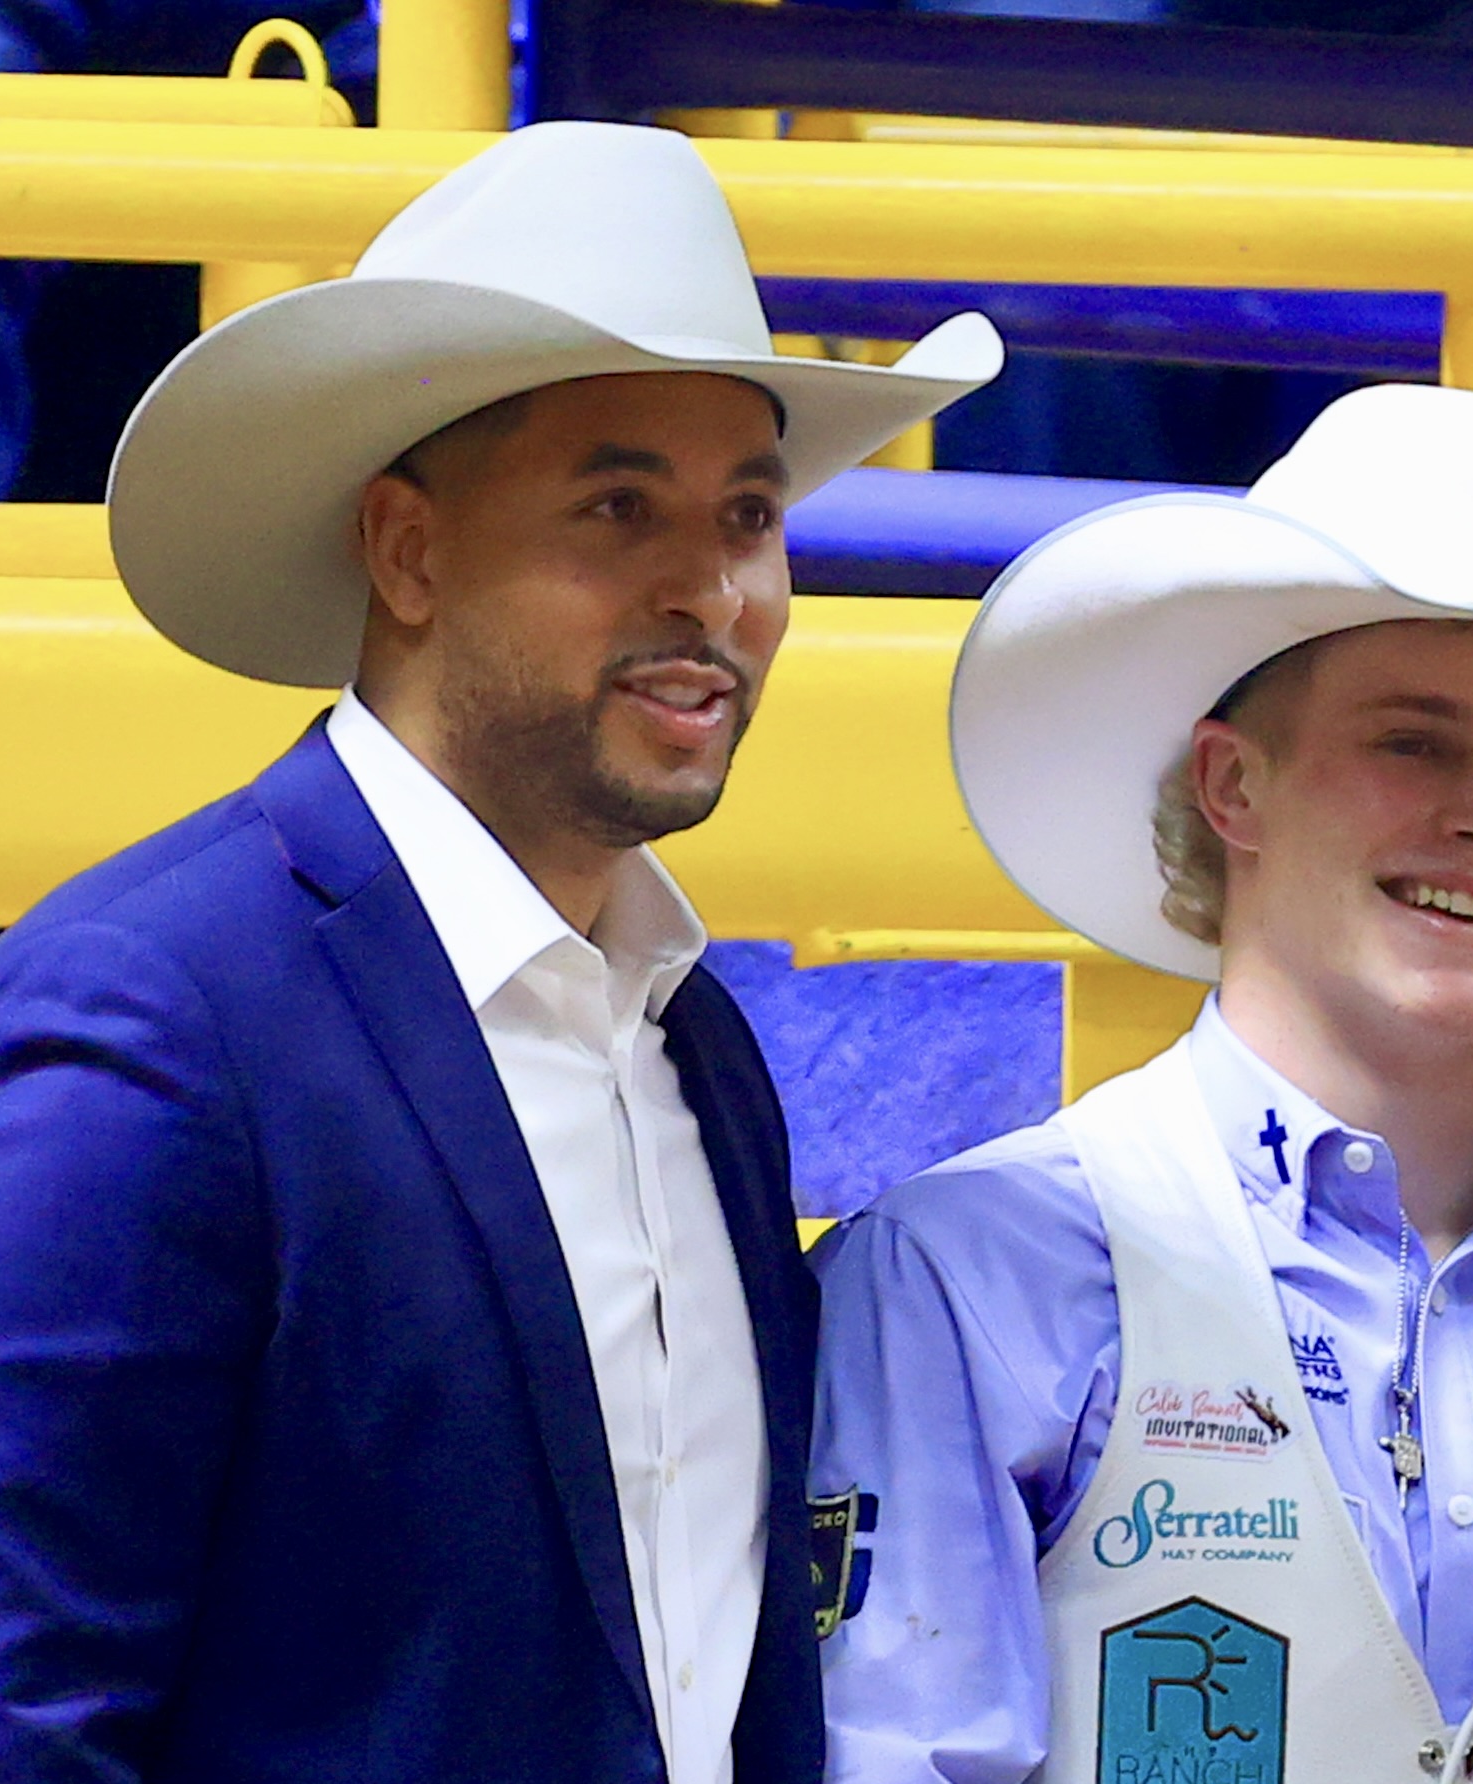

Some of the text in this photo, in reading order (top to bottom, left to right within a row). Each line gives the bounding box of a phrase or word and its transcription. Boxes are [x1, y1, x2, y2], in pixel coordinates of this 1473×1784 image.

[1145, 1417, 1268, 1447] INVITATIONAL
[1093, 1478, 1300, 1568] Serratelli
[1161, 1548, 1294, 1564] HAT COMPANY
